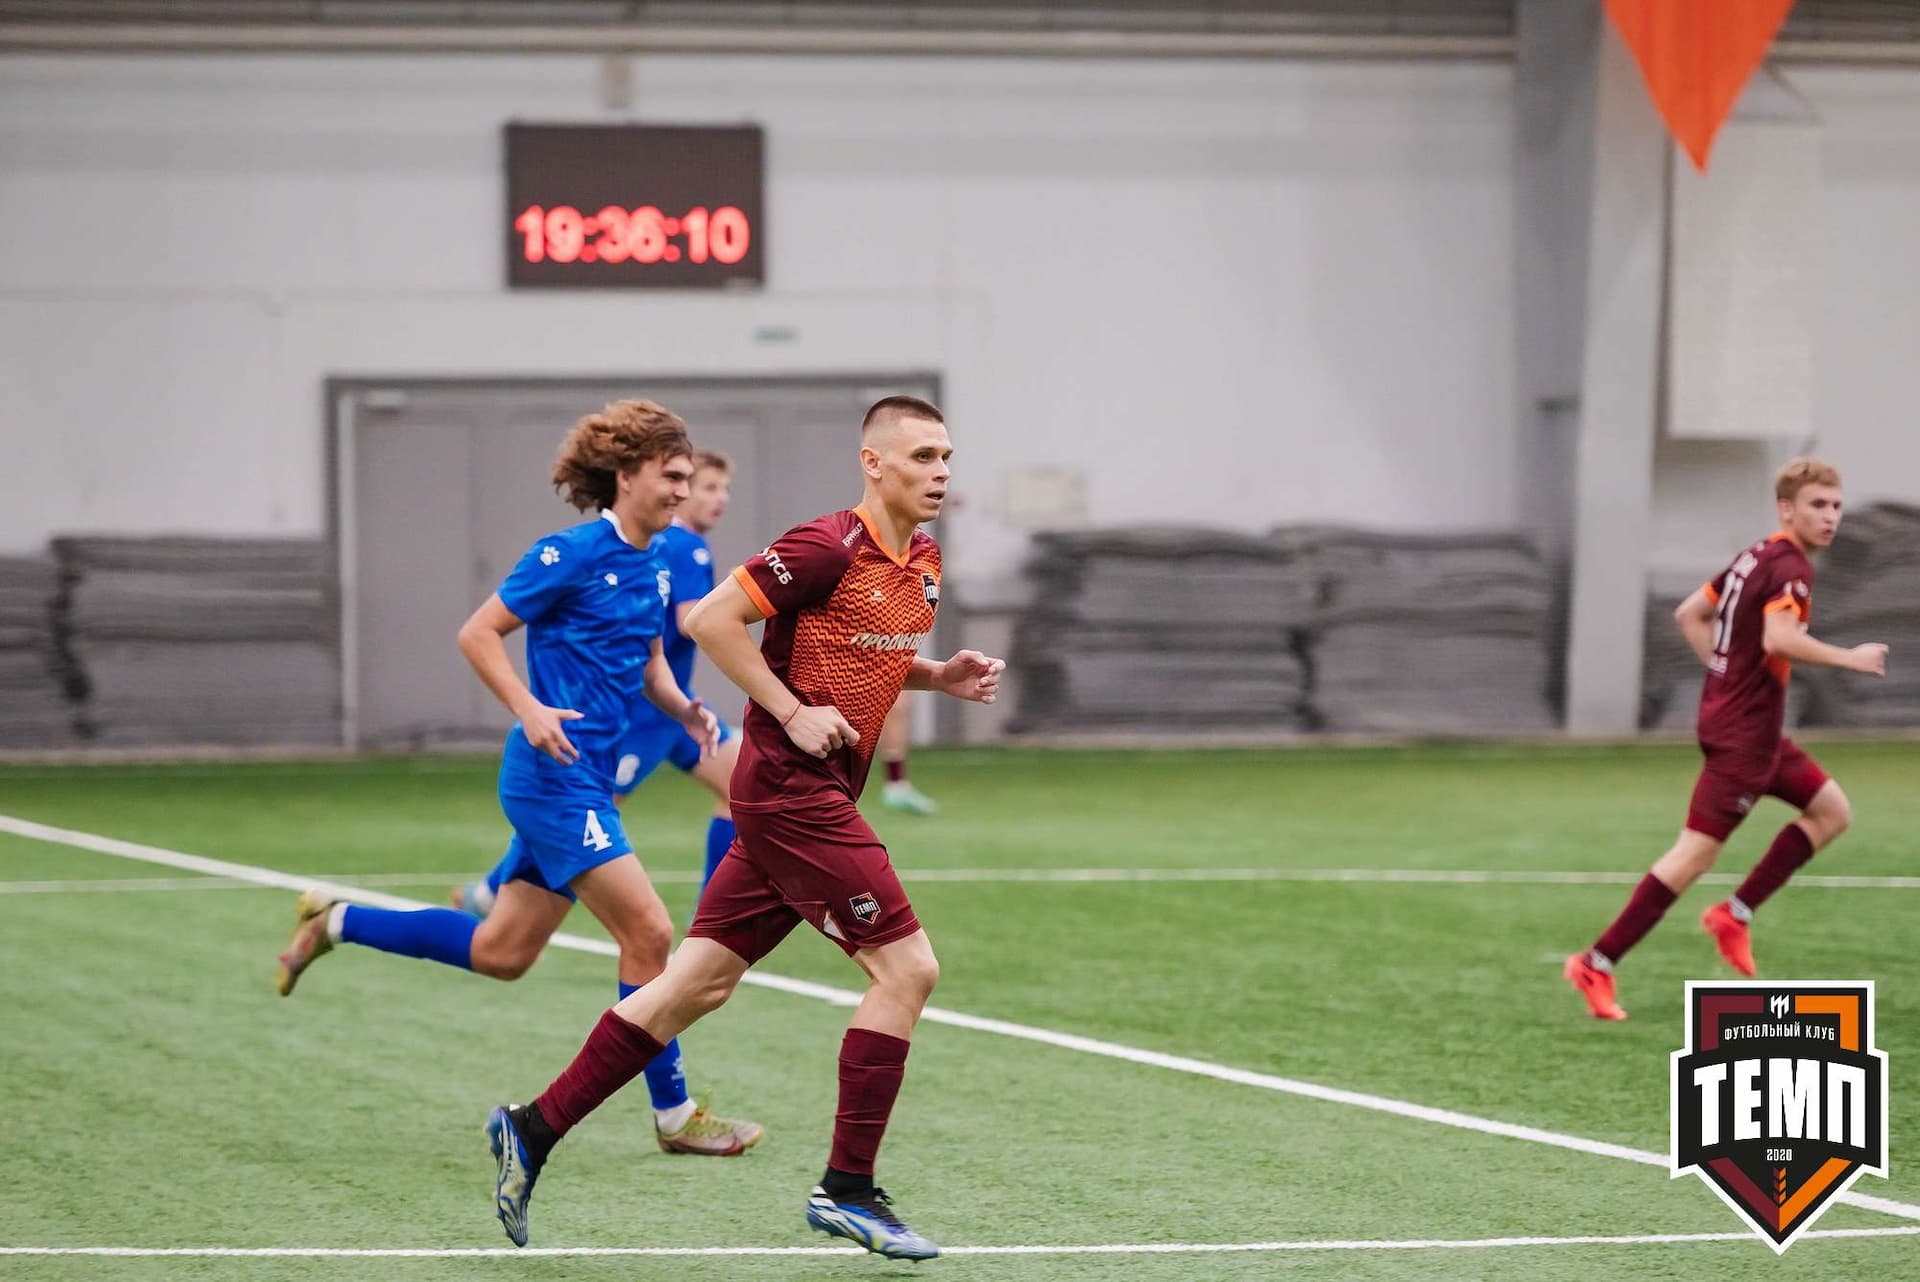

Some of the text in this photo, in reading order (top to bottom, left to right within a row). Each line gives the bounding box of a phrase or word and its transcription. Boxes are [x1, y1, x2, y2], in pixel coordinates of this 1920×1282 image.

[515, 204, 750, 264] 19:36:10
[583, 809, 612, 852] 4
[854, 901, 878, 916] ТЕМП
